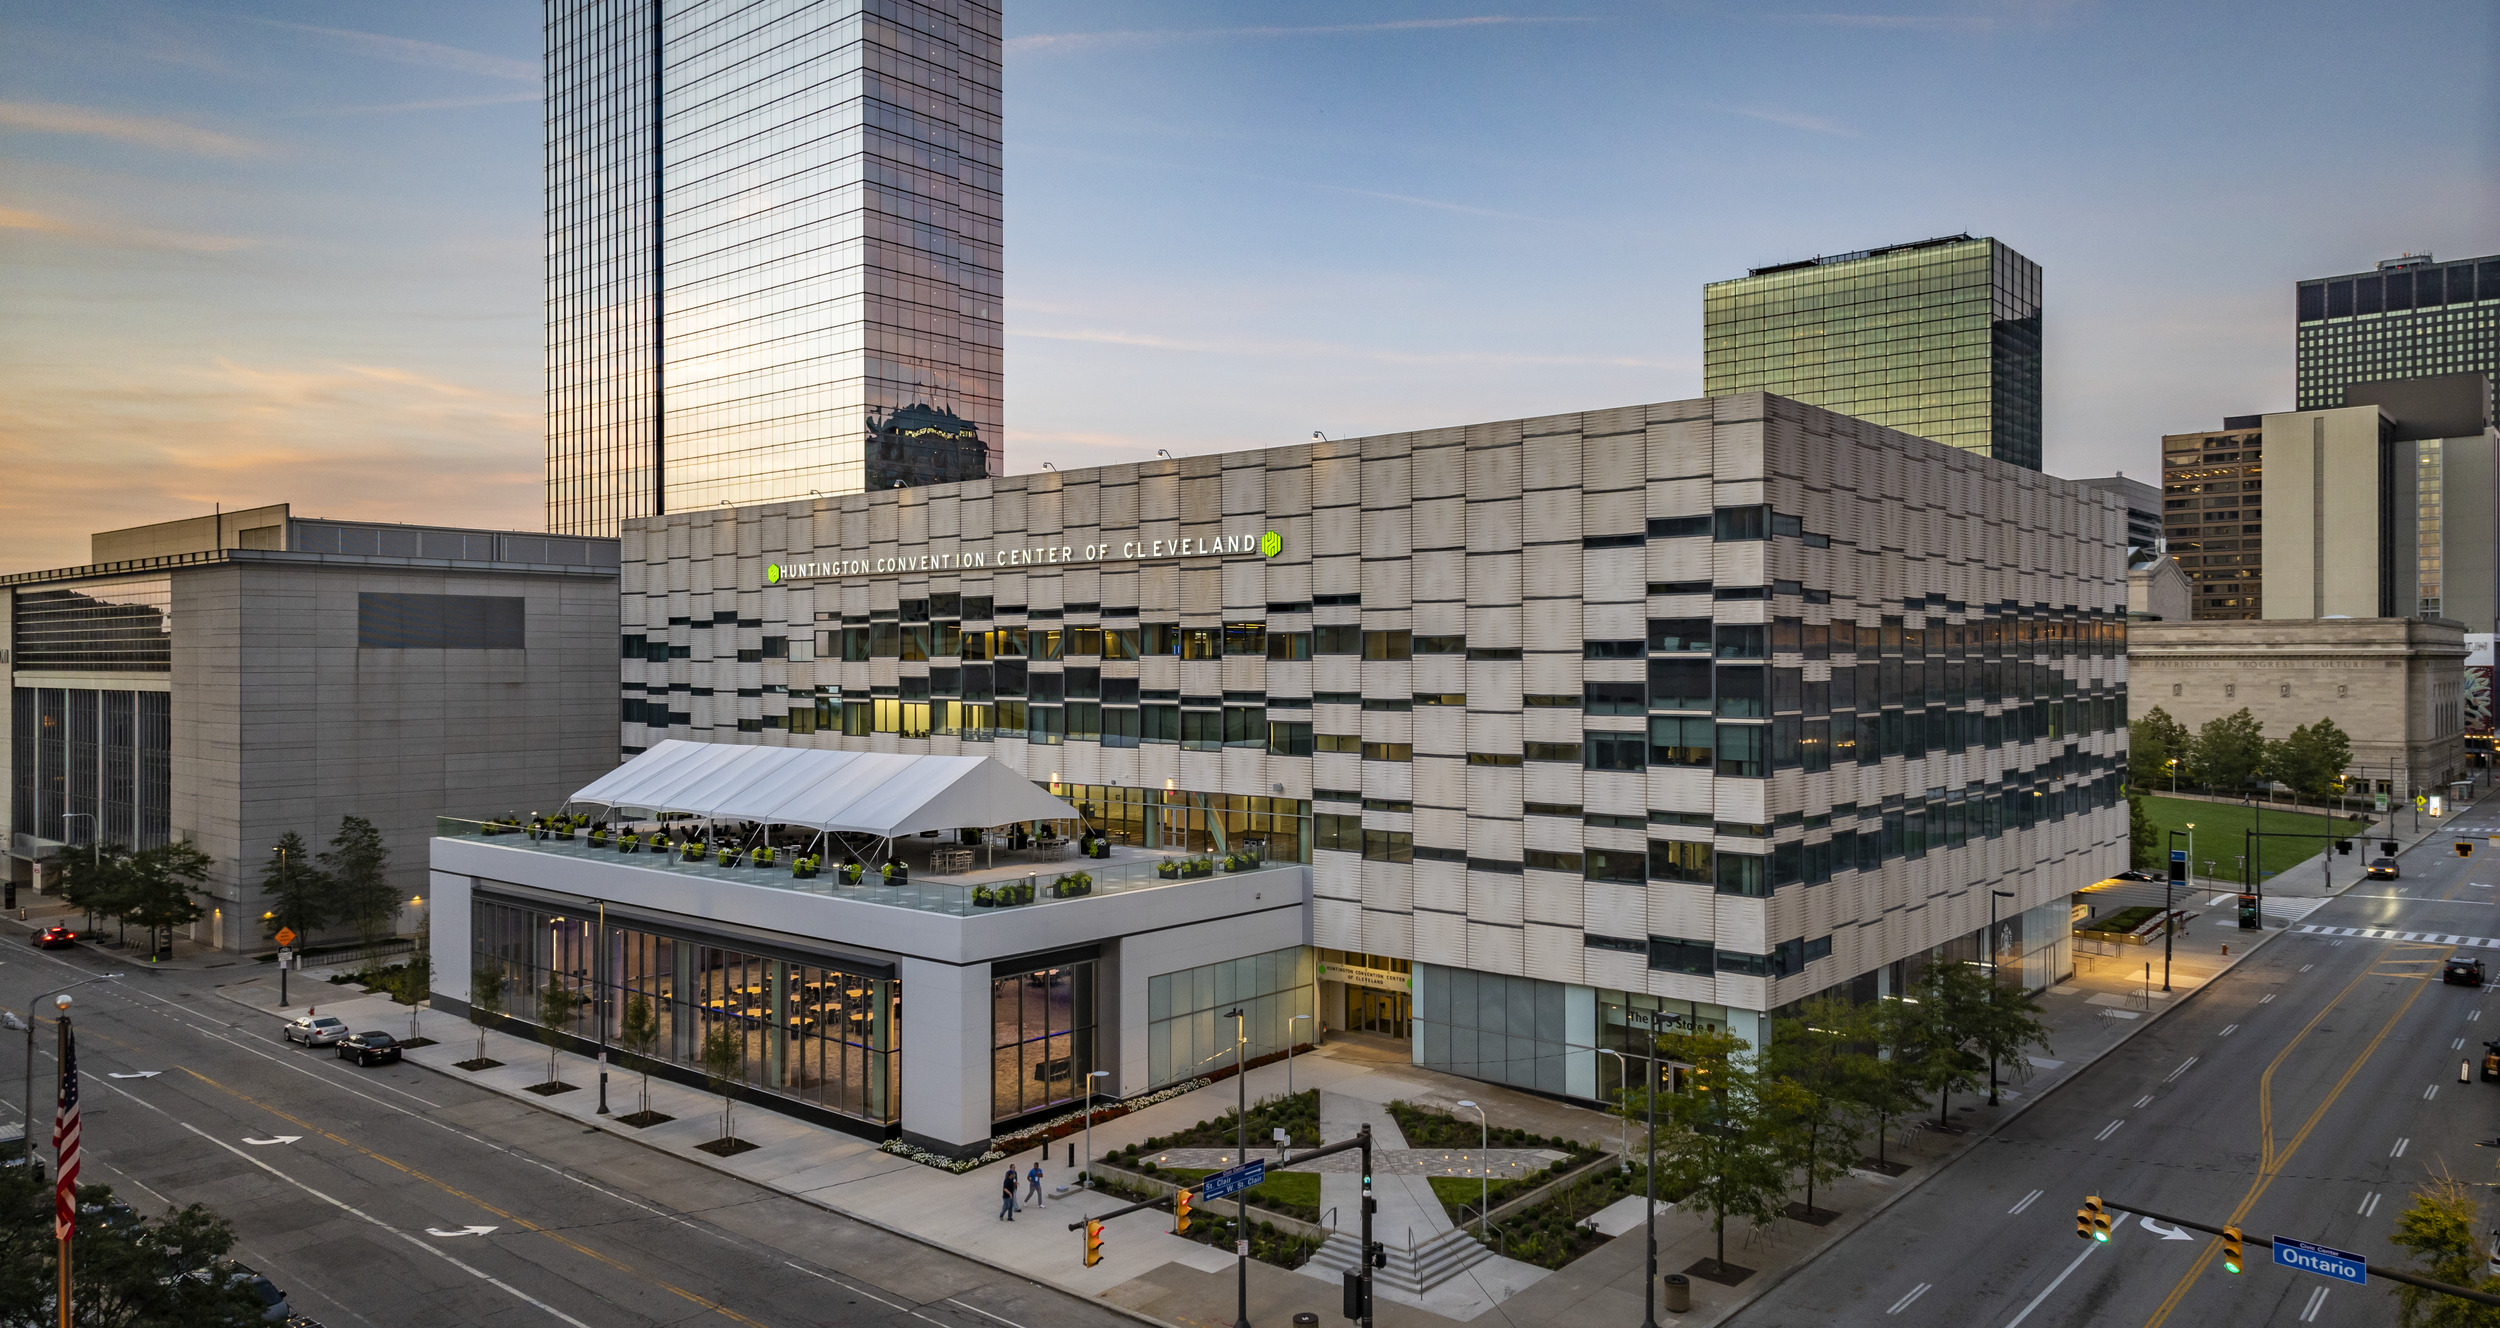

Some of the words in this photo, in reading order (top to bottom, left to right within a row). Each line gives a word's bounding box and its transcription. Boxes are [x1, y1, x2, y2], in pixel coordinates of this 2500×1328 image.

[780, 559, 870, 578] HUNTINGTON
[877, 552, 985, 573] CONVENTION
[997, 546, 1073, 566] CENTER
[1085, 544, 1108, 560] OF
[1123, 534, 1256, 559] CLEVELAND
[1327, 966, 1354, 974] HUNTINGTON
[1355, 970, 1384, 979] CONVENTION
[1355, 976, 1384, 985] CLEVELAND
[1630, 1011, 1649, 1024] The
[1676, 1018, 1704, 1031] Stoe
[1205, 1183, 1215, 1191] St.
[1216, 1176, 1232, 1187] Clair
[1226, 1184, 1235, 1193] W.
[1237, 1181, 1246, 1189] St.
[1247, 1176, 1262, 1186] Clair
[2299, 1242, 2316, 1251] Civic
[2317, 1246, 2340, 1257] Center
[2282, 1248, 2357, 1278] Ontario
